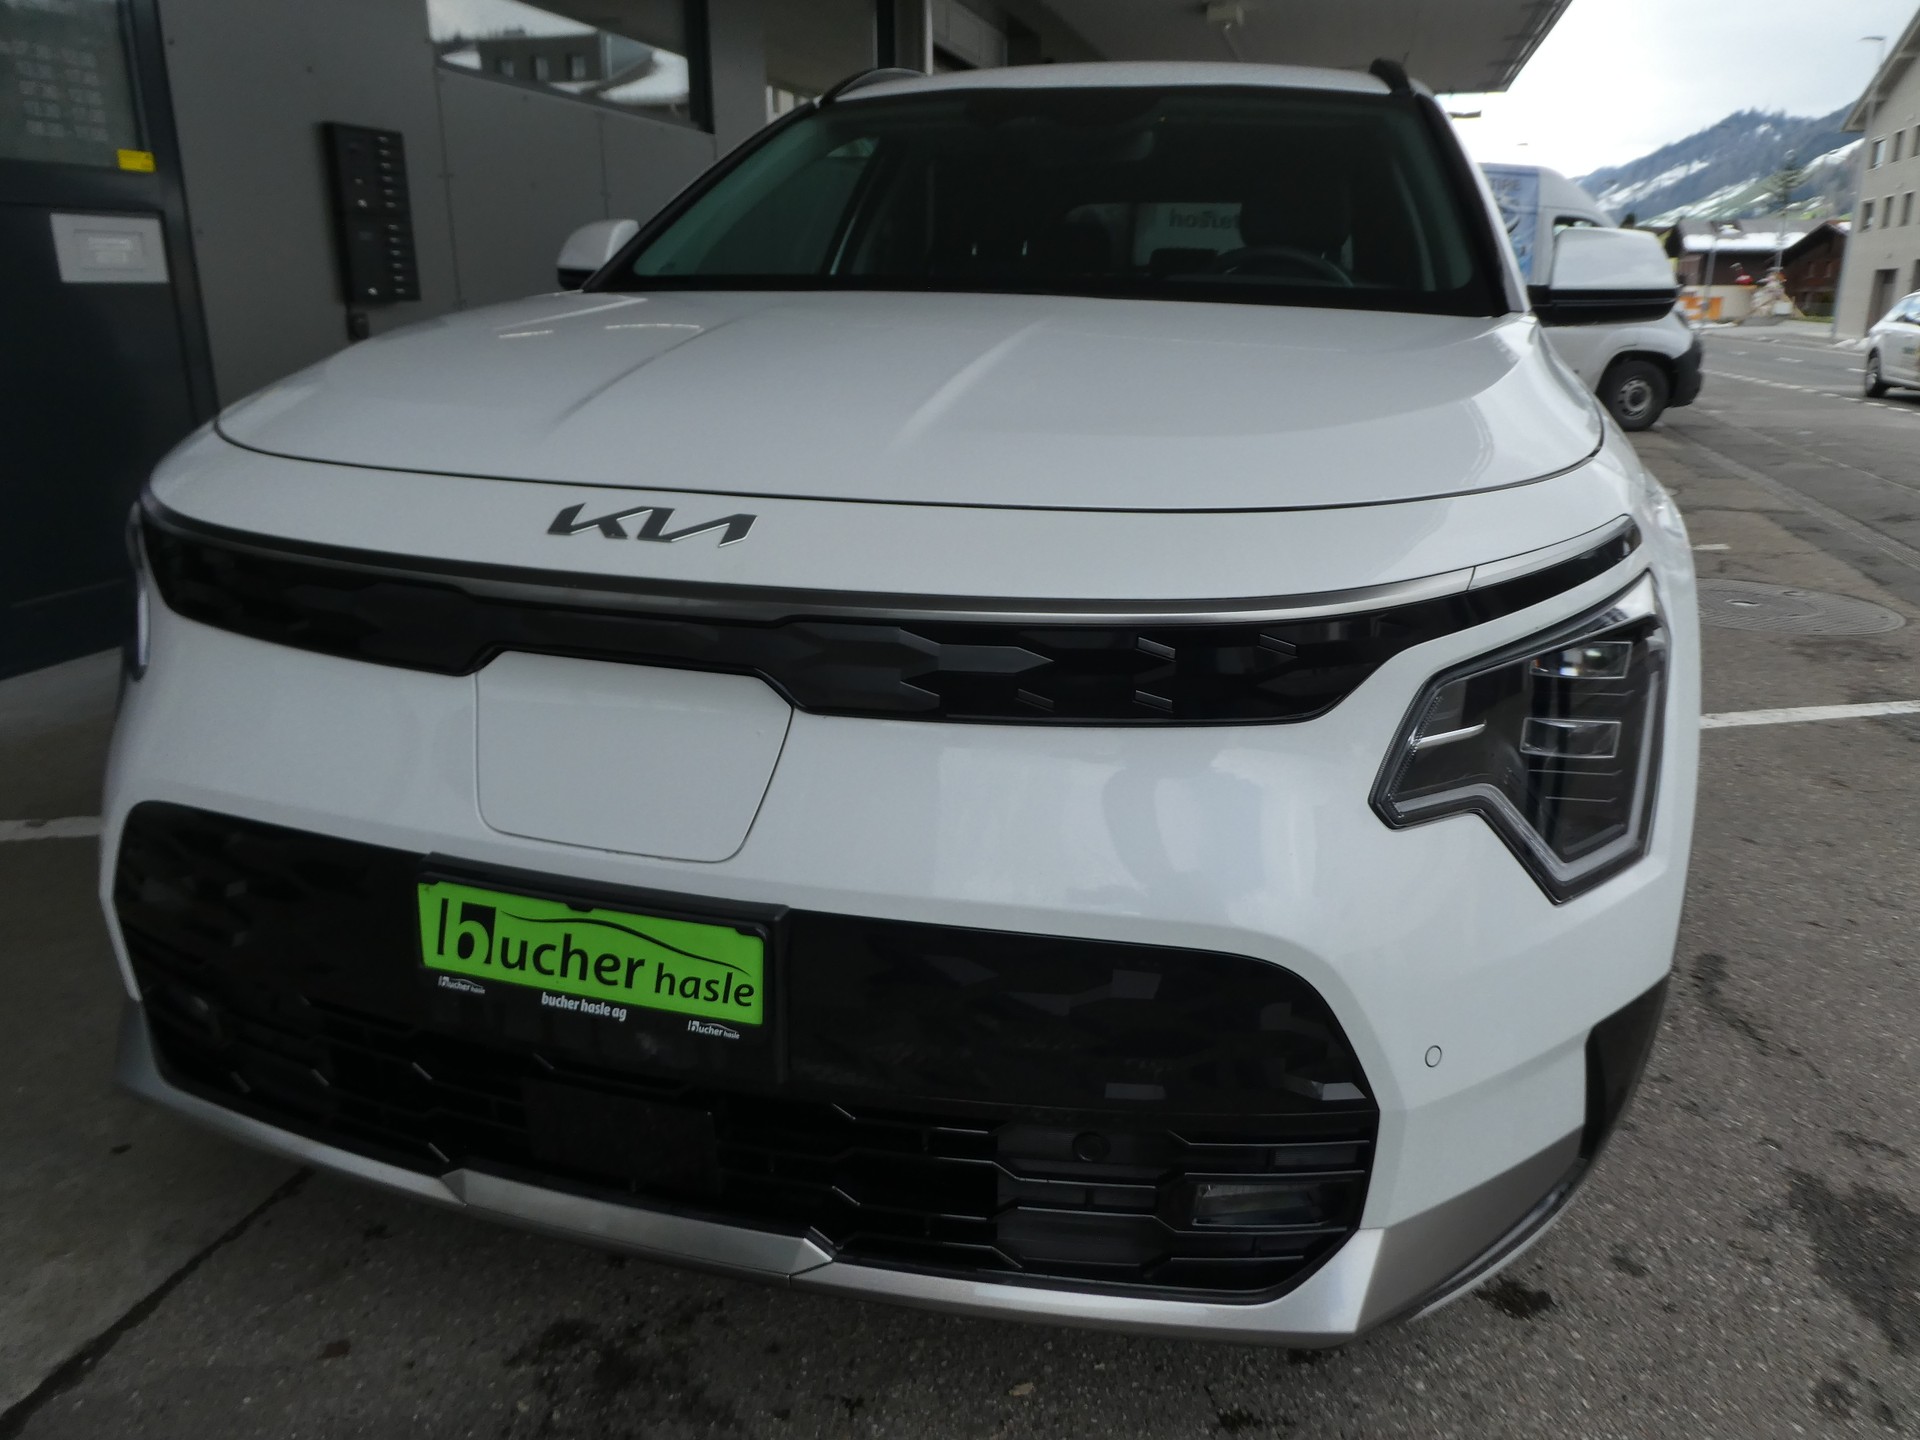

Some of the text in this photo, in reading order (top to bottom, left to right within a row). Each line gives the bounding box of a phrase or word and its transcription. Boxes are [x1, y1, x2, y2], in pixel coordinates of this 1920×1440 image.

[547, 503, 758, 547] KIA
[541, 992, 627, 1022] bucher hasle ag
[654, 963, 755, 1007] hasle
